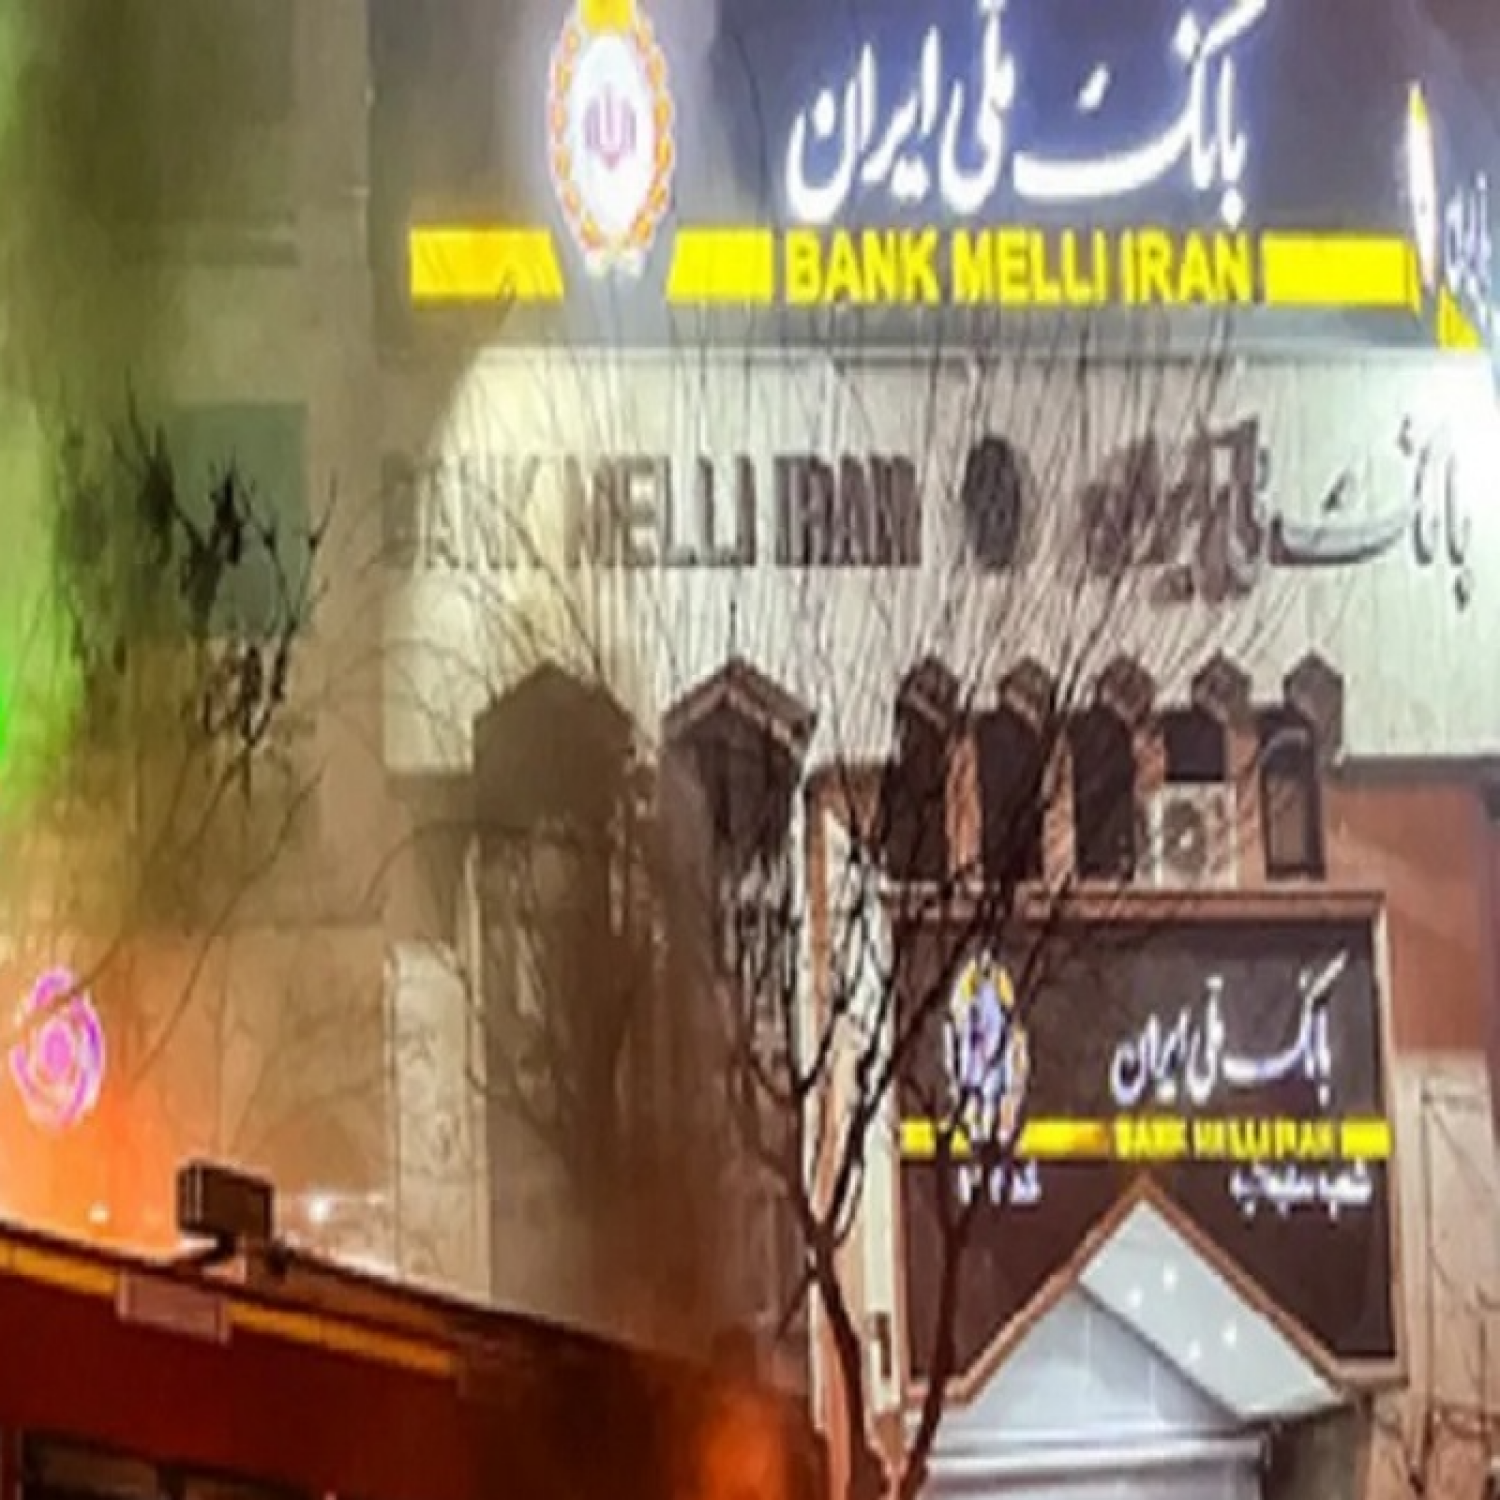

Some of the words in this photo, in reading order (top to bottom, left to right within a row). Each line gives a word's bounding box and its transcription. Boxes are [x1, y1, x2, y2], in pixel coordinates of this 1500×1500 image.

[786, 25, 941, 223] ایران
[1013, 0, 1266, 228] بانک
[784, 229, 941, 306] BANK
[950, 229, 1109, 306] MELLI
[1121, 229, 1252, 306] IRAN
[773, 454, 924, 569] IRAN
[1109, 1005, 1190, 1106] ایران
[1220, 949, 1350, 1107] بانک
